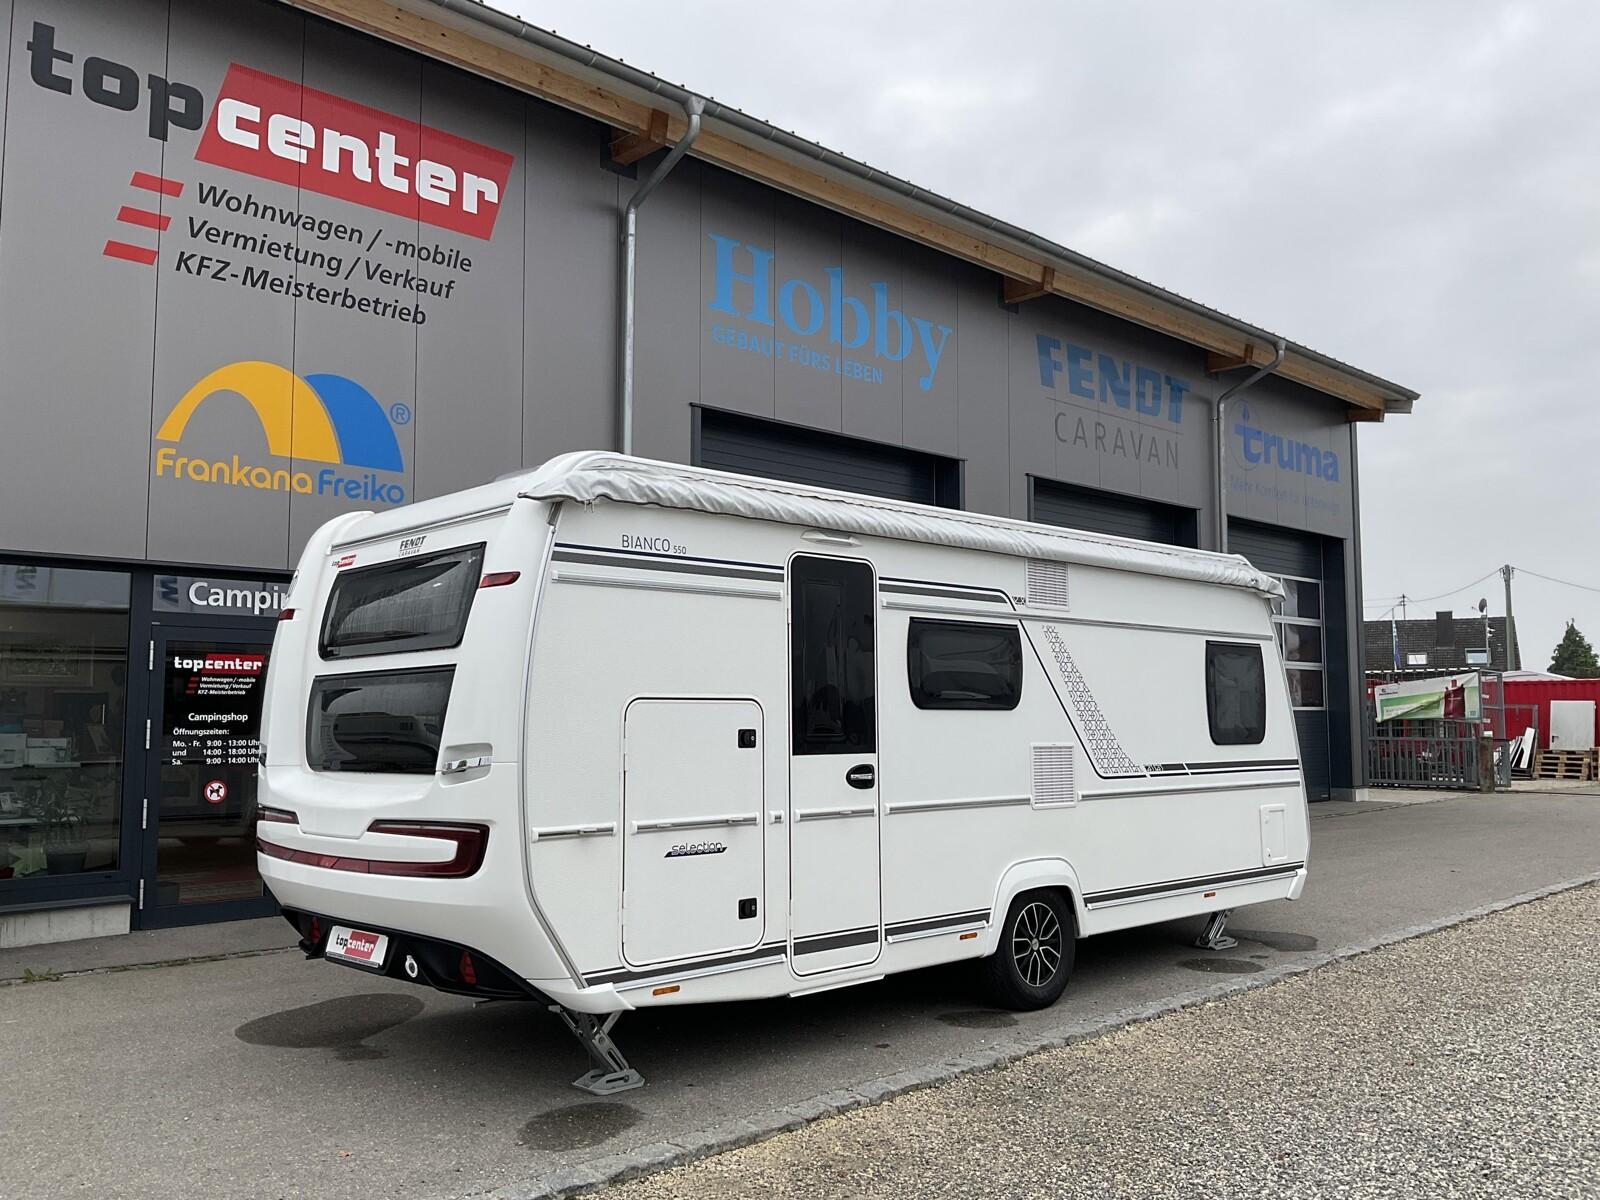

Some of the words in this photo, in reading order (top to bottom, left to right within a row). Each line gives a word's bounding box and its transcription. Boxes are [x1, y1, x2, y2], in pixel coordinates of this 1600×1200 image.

[198, 182, 363, 244] Wohnwagen
[187, 216, 343, 277] Vermietung
[365, 260, 455, 299] Verkauf
[175, 250, 427, 326] KFZ-Meisterbetrieb
[708, 233, 953, 391] Hobby
[711, 324, 785, 360] GEBAUT
[787, 343, 831, 371] FÜRS
[835, 356, 884, 385] LEBEN
[1036, 334, 1191, 424] FENDT
[1054, 411, 1180, 470] CARAVAN
[1234, 420, 1339, 482] truma
[156, 447, 313, 494] Frankana
[318, 469, 405, 504] Freiko
[400, 535, 427, 550] FENDT
[621, 534, 671, 552] BIANCO
[673, 545, 687, 555] 550
[172, 740, 187, 748] Mo.
[192, 740, 201, 748] Fr.
[206, 739, 222, 747] 9:00
[228, 739, 247, 747] 13:00
[173, 727, 230, 737] Öffnungszeiten:
[188, 712, 249, 723] Campingshop
[171, 758, 183, 766] Sa.
[206, 757, 222, 765] 9:00
[172, 748, 187, 756] und
[202, 748, 222, 756] 14:00
[671, 841, 723, 856] selection
